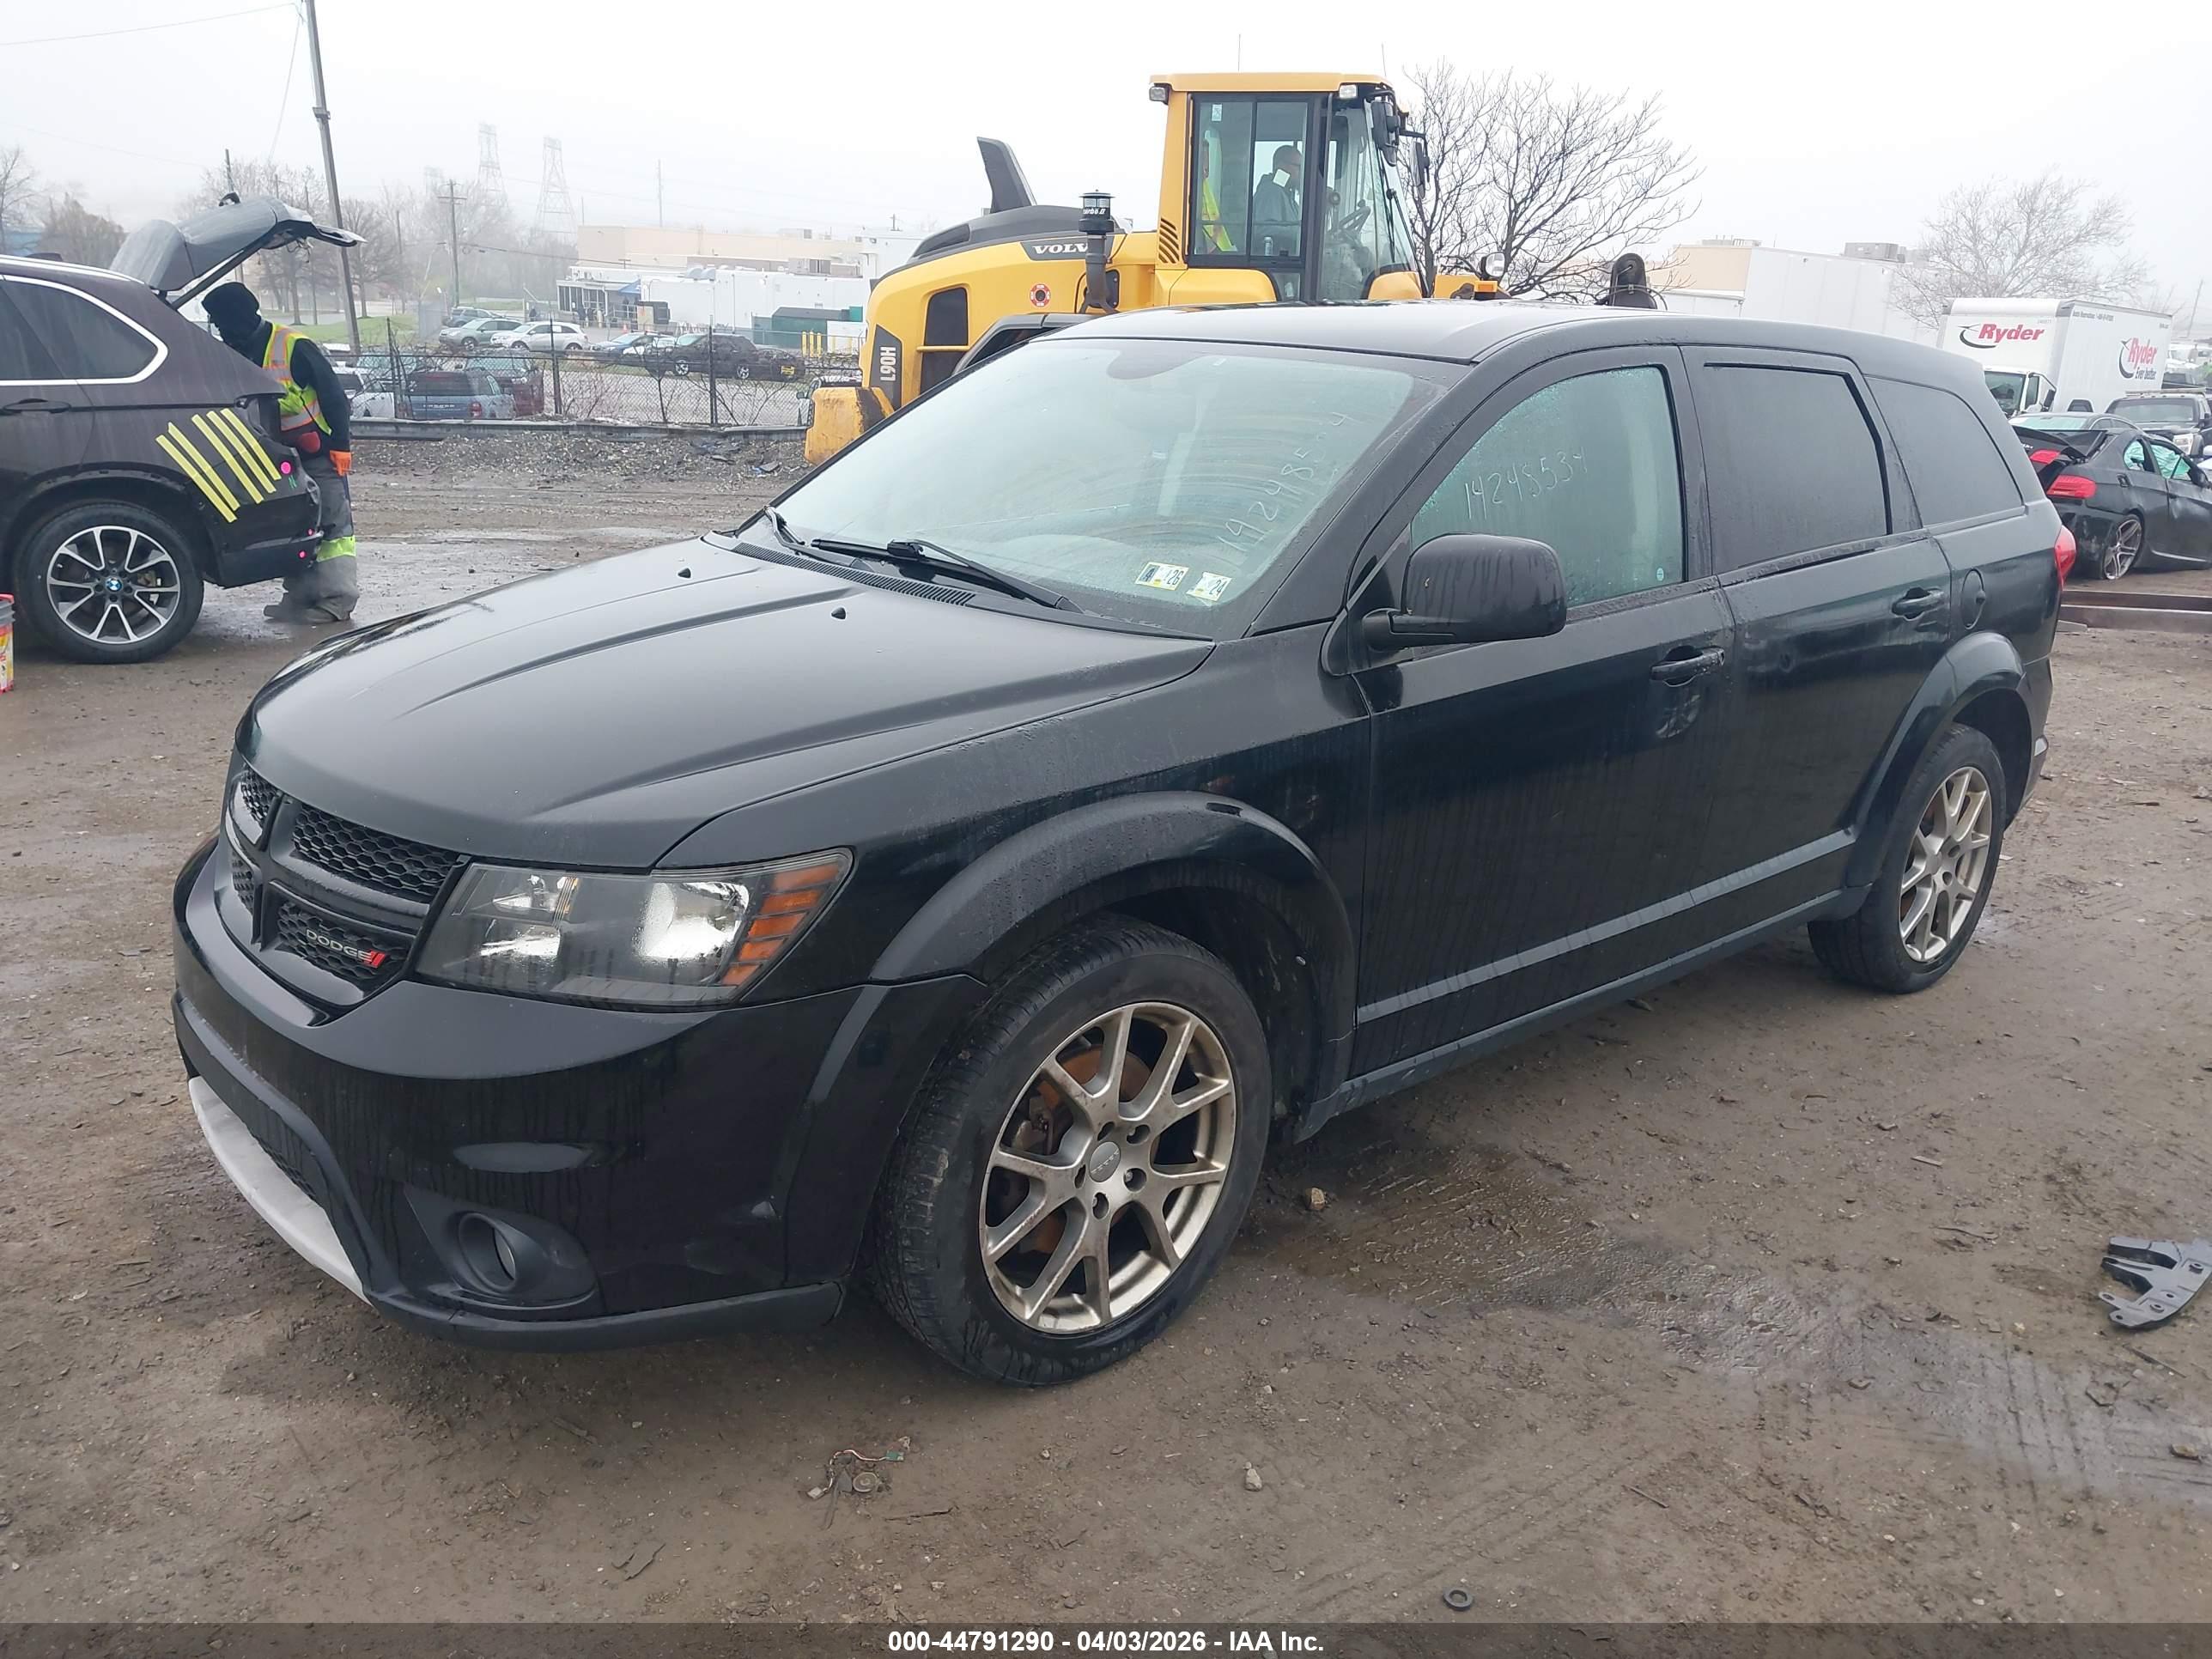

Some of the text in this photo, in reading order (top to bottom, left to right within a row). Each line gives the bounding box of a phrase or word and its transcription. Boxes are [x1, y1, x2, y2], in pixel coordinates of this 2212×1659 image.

[1031, 242, 1088, 255] VOLV
[1978, 324, 2045, 343] Ryder
[2127, 337, 2158, 369] Ryder
[879, 346, 896, 382] L90H
[1166, 569, 1185, 586] 26
[1209, 579, 1228, 597] 24
[306, 928, 373, 963] DODGE
